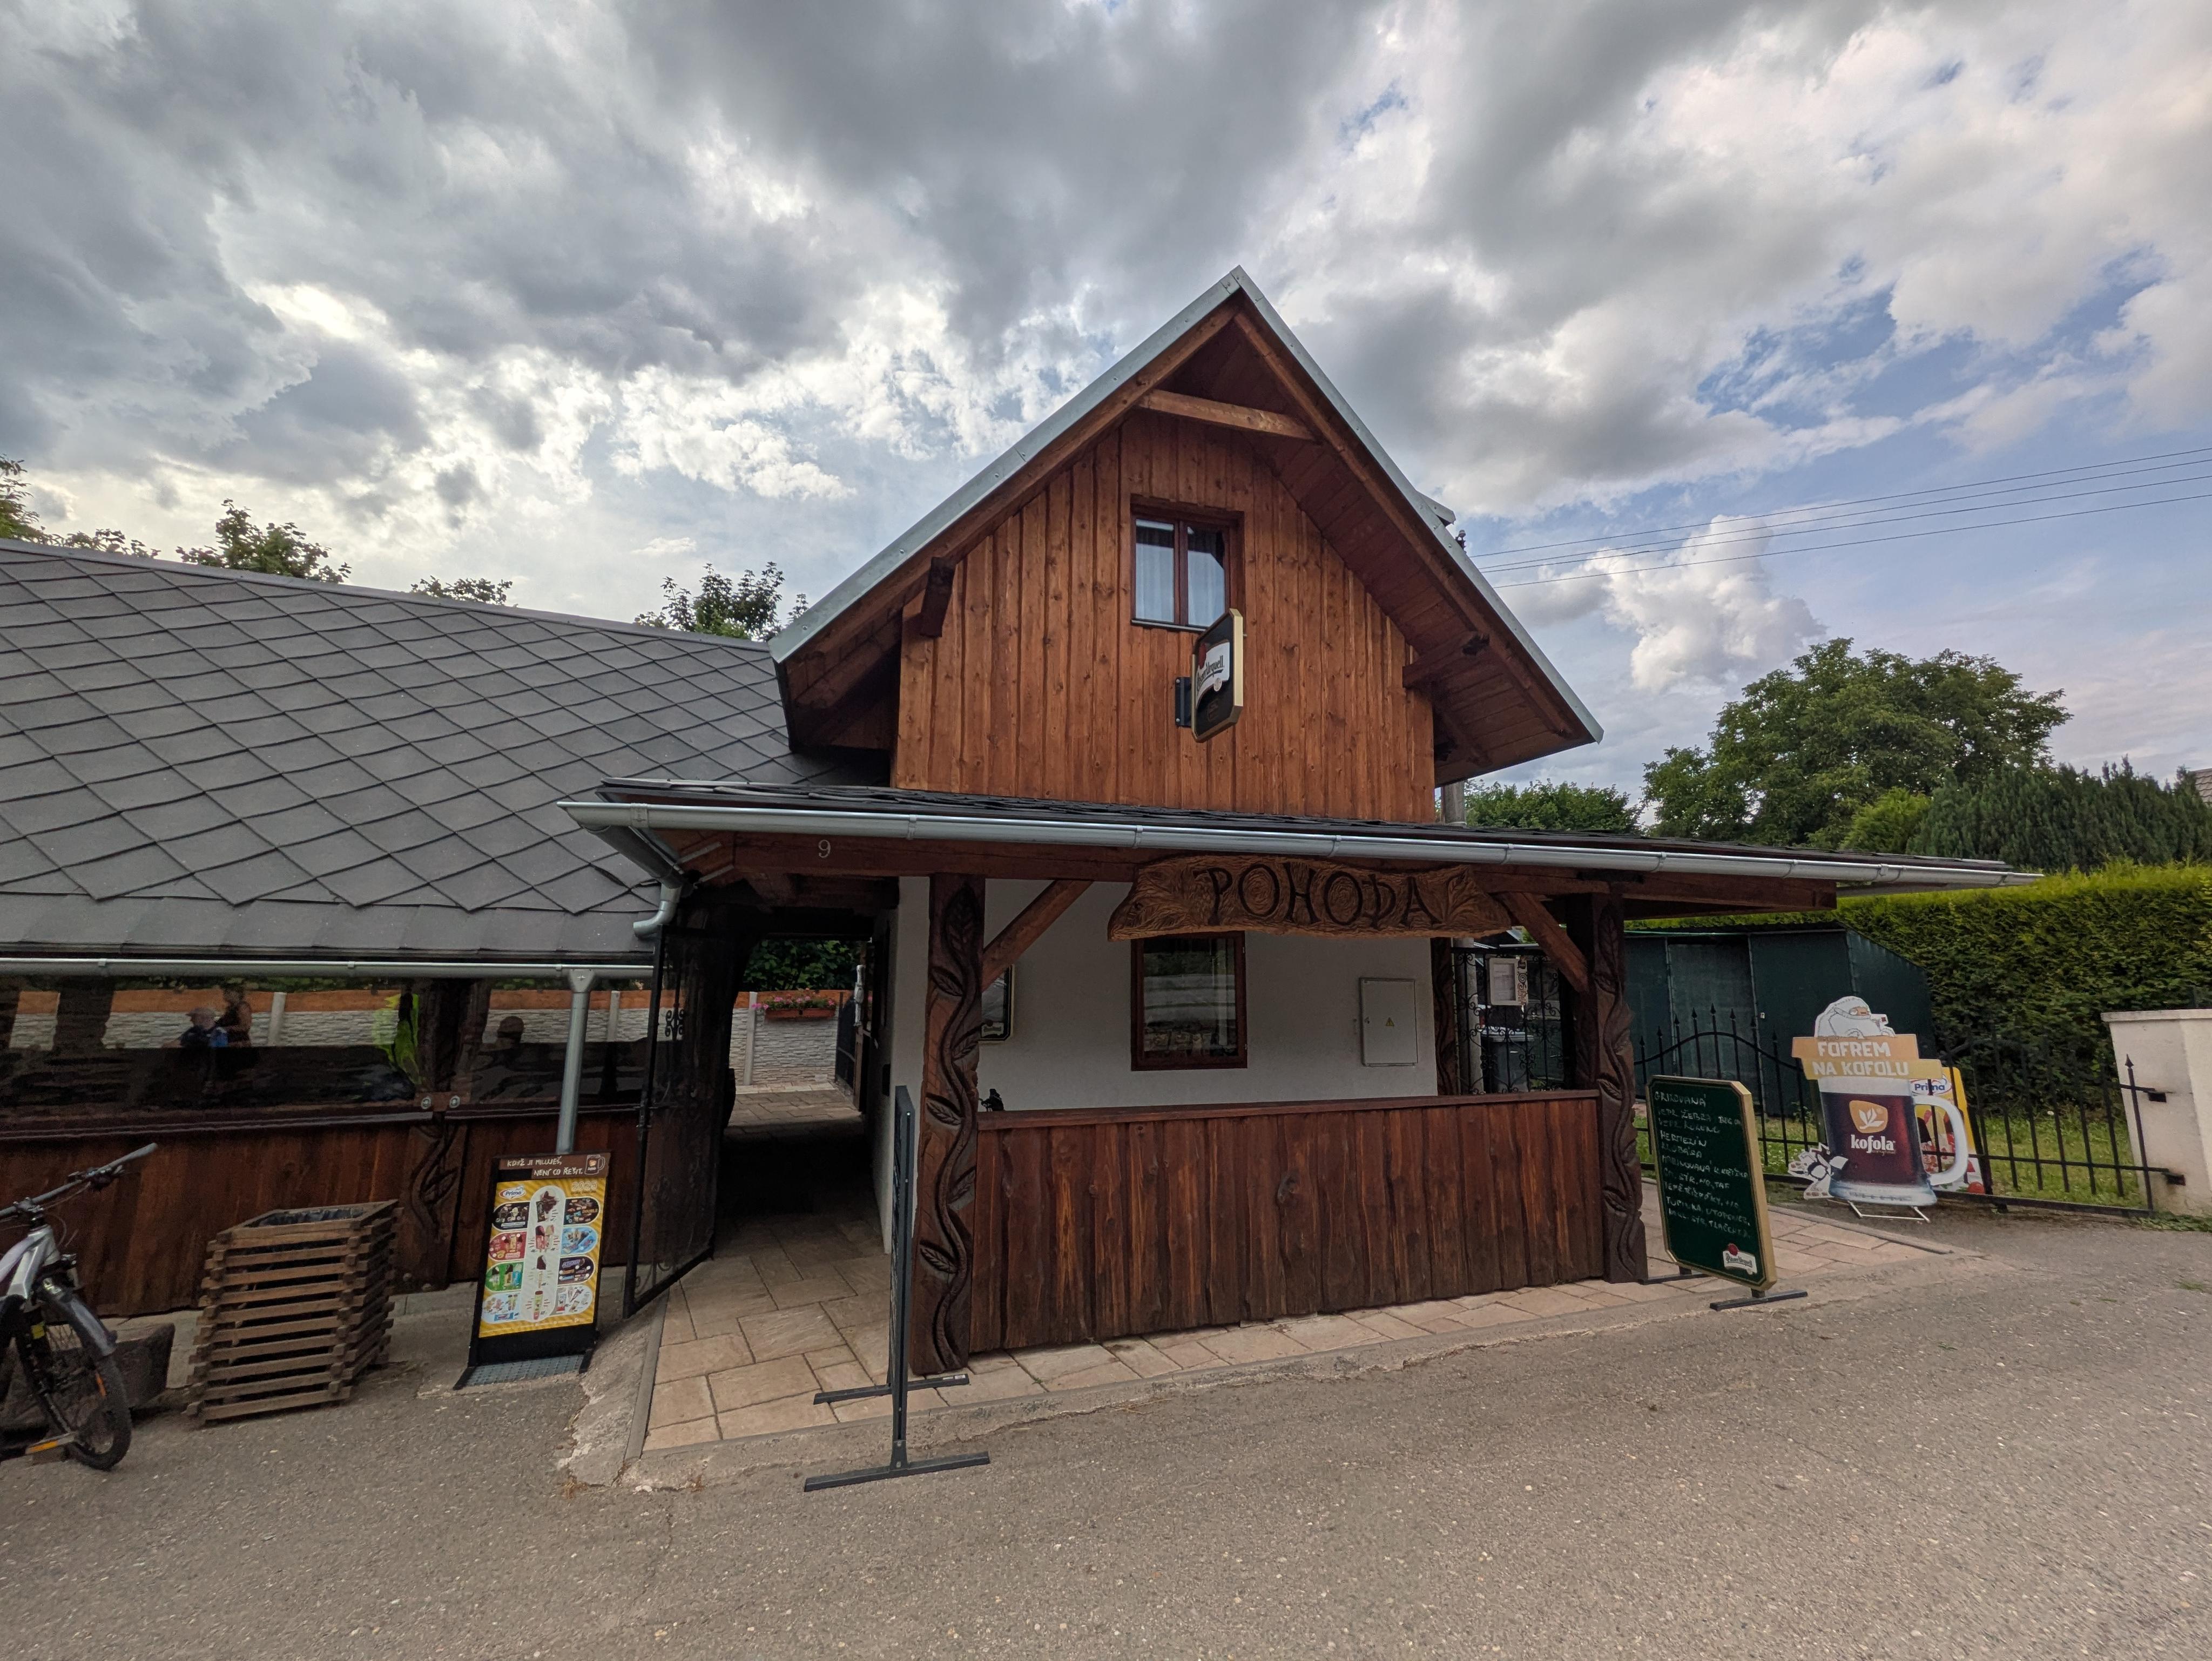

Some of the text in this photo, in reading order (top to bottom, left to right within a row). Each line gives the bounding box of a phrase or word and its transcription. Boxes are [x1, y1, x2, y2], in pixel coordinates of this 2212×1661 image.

[818, 840, 831, 858] 9
[1193, 863, 1442, 930] POHODA
[1817, 1041, 1891, 1057] FOFREM
[1811, 1061, 1910, 1076] NA KOFOLU
[1914, 1083, 1945, 1091] Prima
[1851, 1135, 1894, 1153] kofola
[507, 1158, 525, 1167] KDYŽ
[534, 1169, 551, 1177] NENÍ
